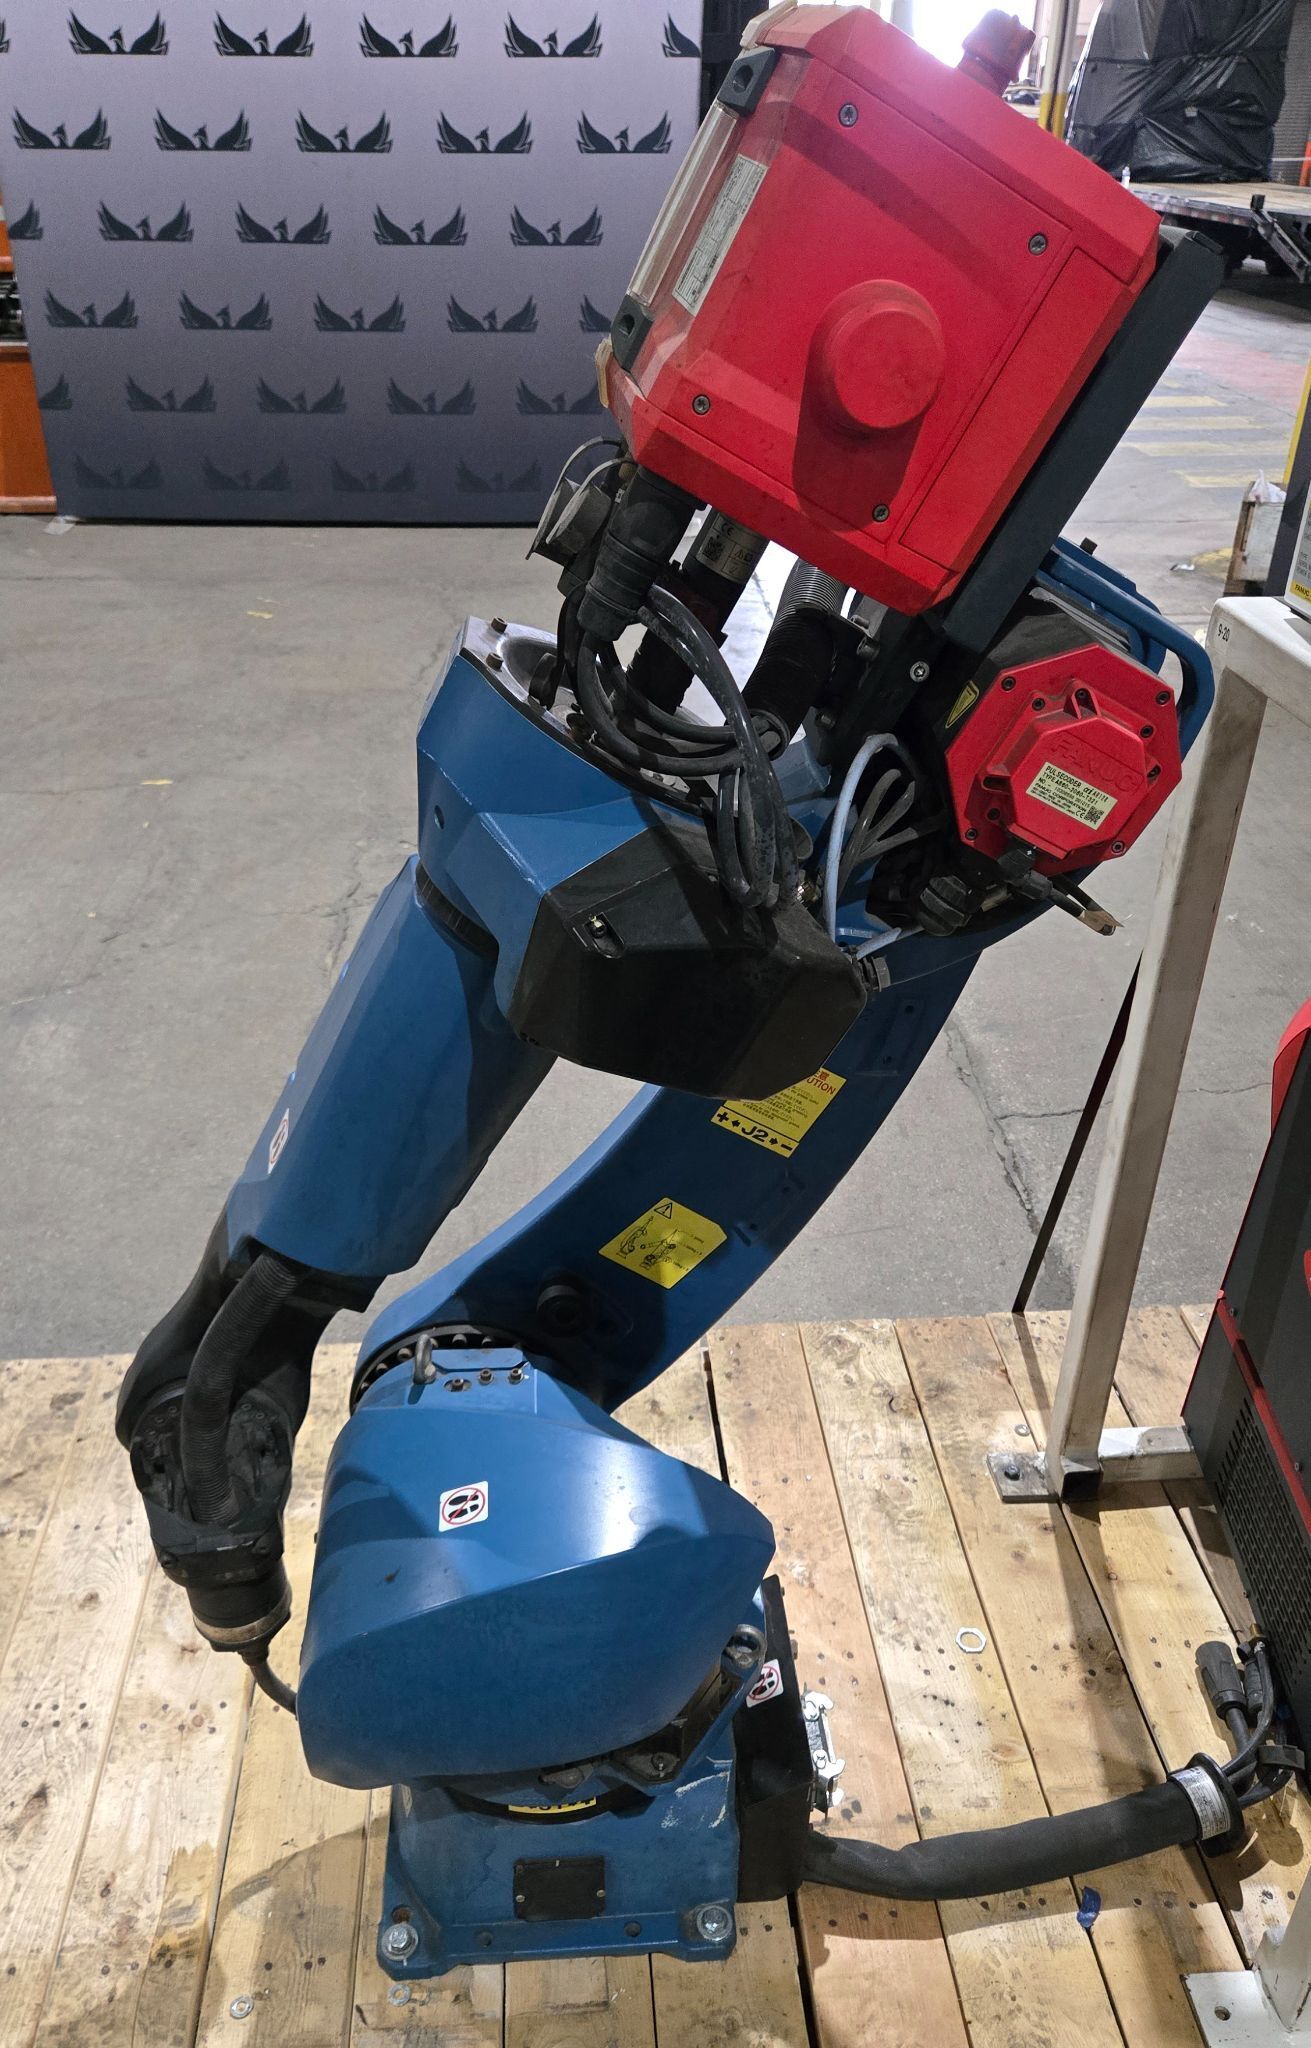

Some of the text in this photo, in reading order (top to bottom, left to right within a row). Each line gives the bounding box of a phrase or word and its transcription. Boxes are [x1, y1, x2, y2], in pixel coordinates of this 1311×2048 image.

[1295, 584, 1310, 597] FANUC
[1218, 624, 1230, 642] 9-20
[1042, 773, 1056, 783] TYPE
[1045, 766, 1082, 788] PULSECODER
[1052, 792, 1087, 812] CORPORATION
[807, 1077, 836, 1095] UTION
[741, 1126, 769, 1143] J2
